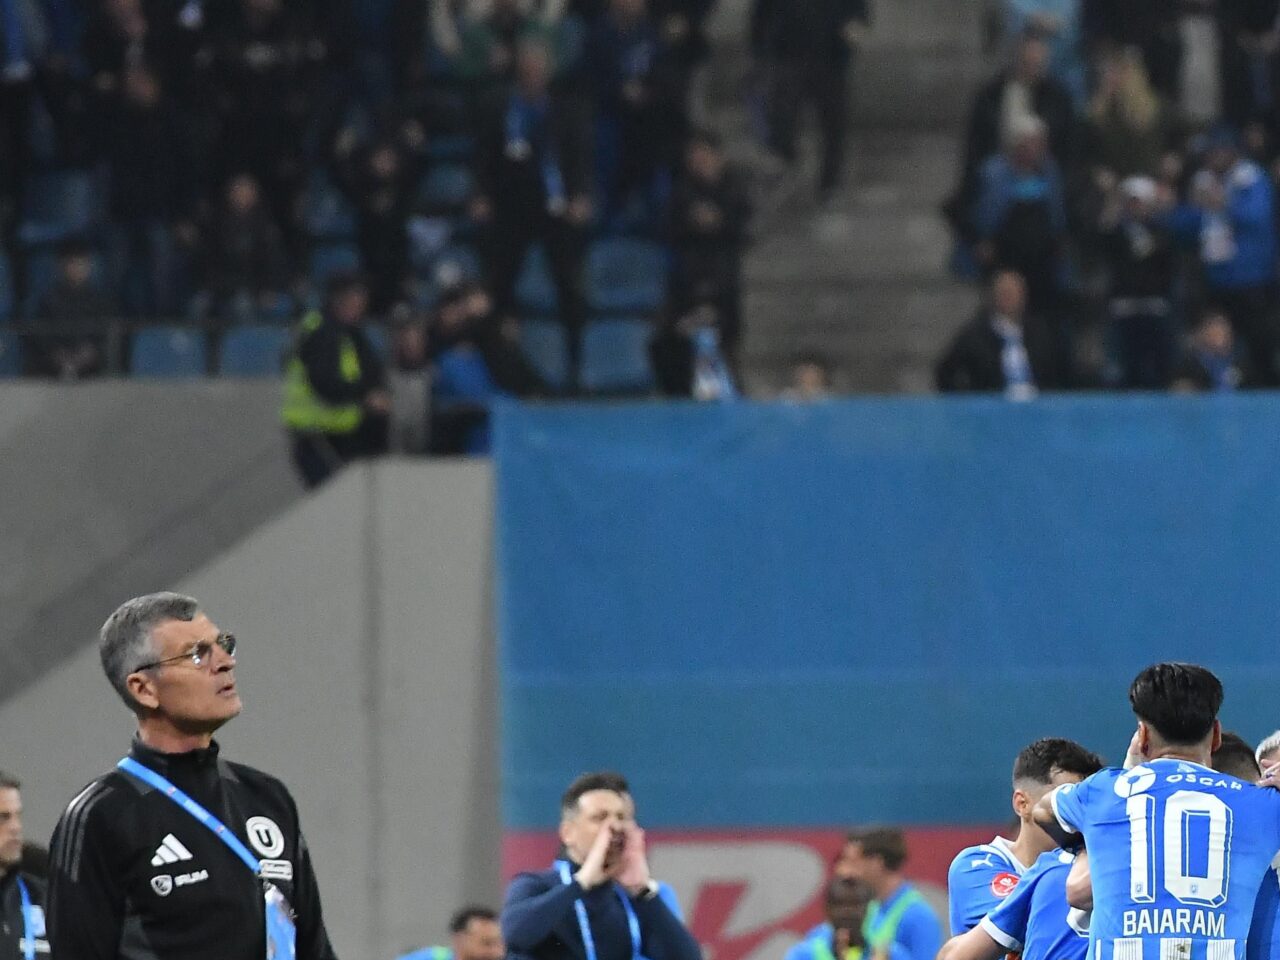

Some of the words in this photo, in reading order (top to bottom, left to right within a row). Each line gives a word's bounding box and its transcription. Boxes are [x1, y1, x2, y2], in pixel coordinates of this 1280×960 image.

[1166, 774, 1242, 790] OSCAR
[1126, 790, 1233, 908] 10
[1123, 908, 1225, 937] BAIARAM
